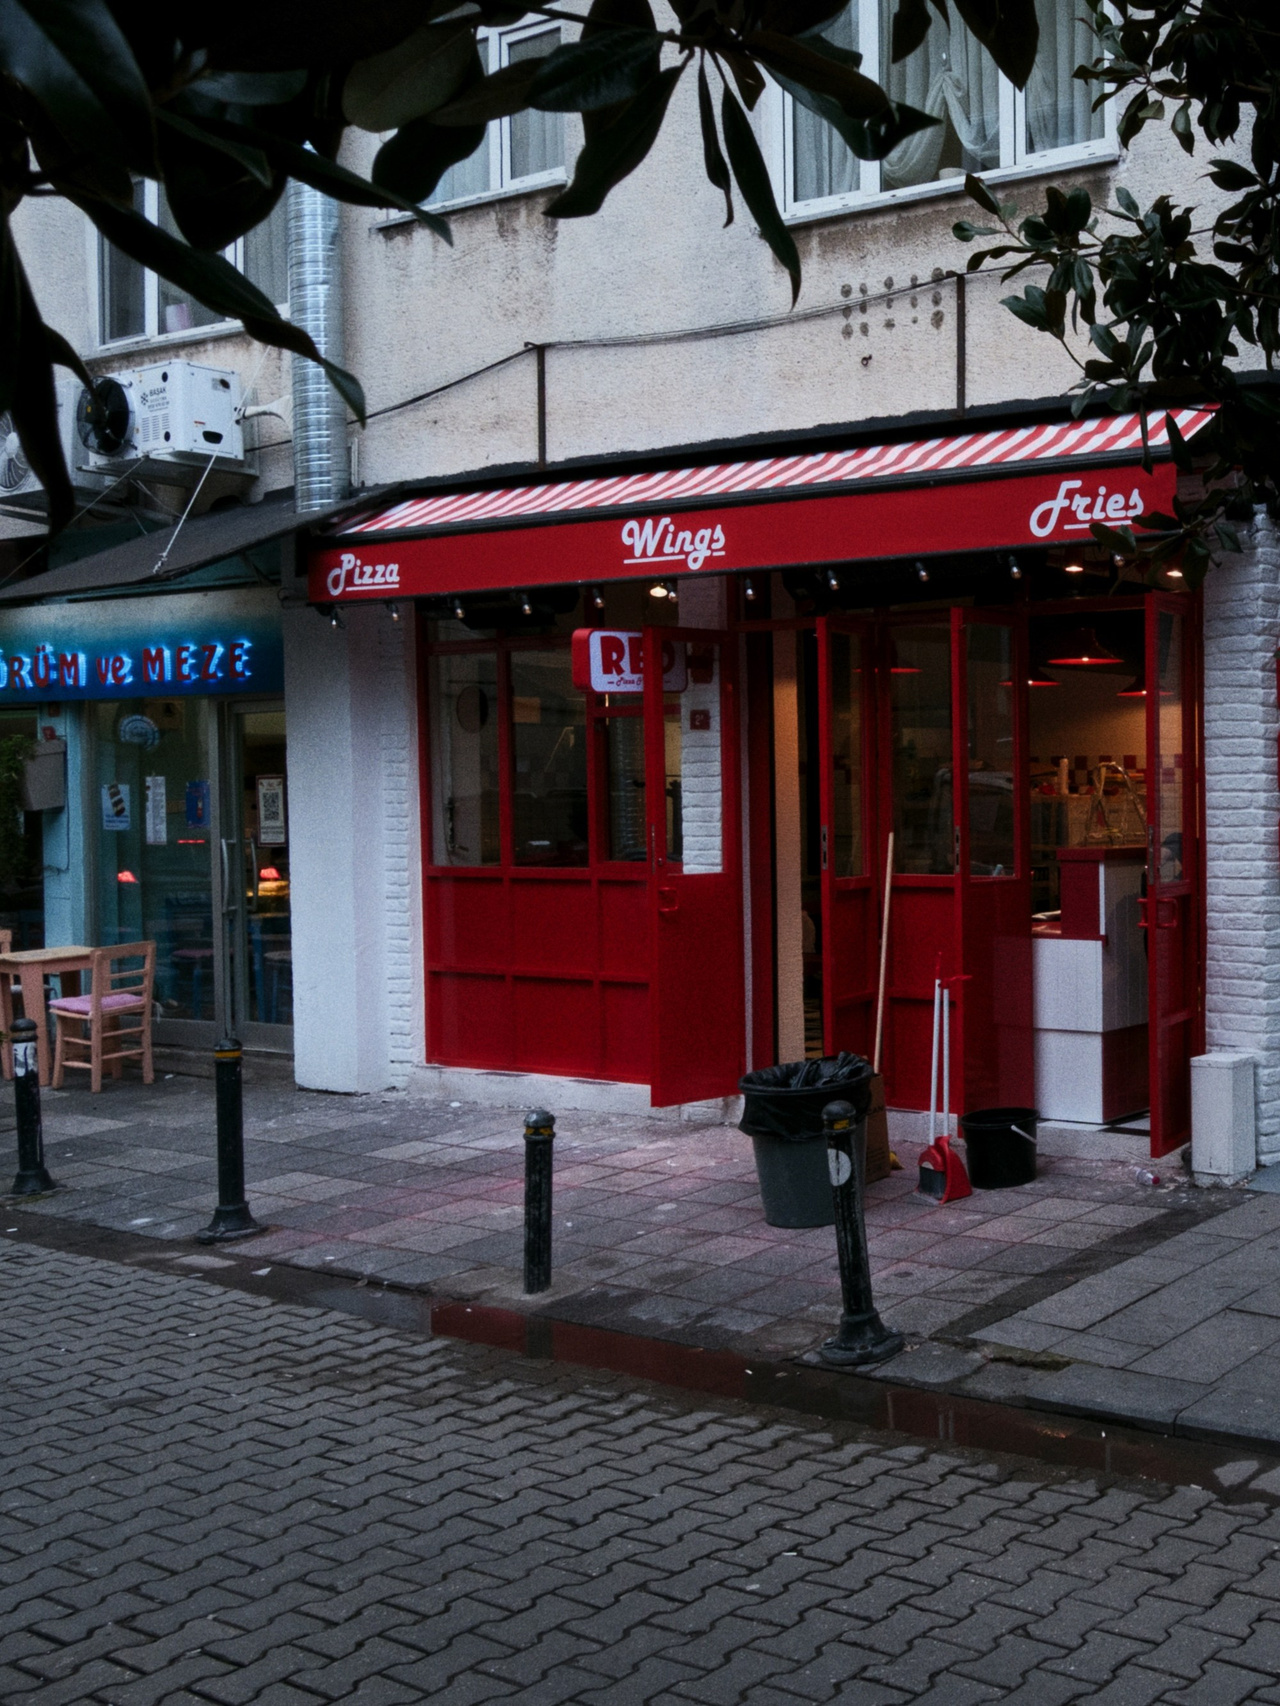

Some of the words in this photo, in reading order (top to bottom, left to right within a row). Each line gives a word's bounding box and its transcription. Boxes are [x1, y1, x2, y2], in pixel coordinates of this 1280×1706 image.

[1029, 480, 1144, 538] Fries
[622, 517, 726, 570] Wings
[327, 553, 400, 596] Pizza
[142, 641, 249, 684] MEZE
